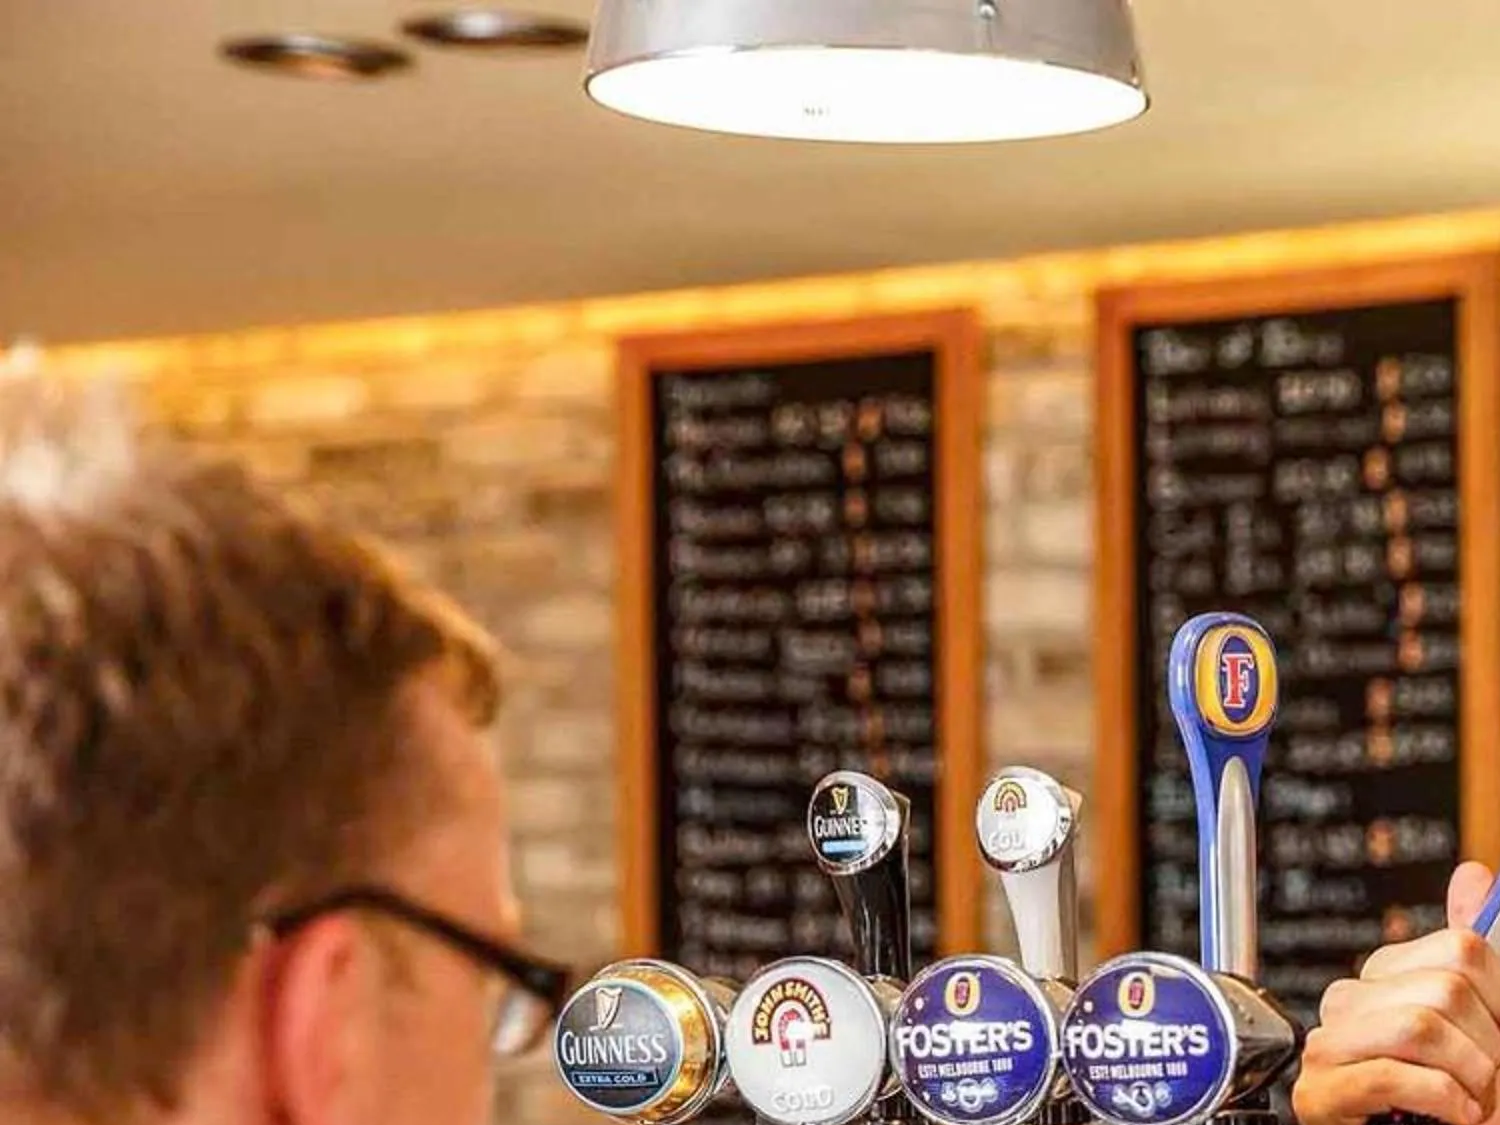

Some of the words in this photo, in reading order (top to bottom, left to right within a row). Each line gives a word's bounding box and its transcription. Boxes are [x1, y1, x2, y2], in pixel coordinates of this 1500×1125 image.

[1221, 653, 1255, 709] F
[814, 815, 871, 839] GUINNE
[754, 984, 784, 1042] JOHN
[561, 1031, 668, 1065] GUINNESS
[896, 1020, 1034, 1060] FOSTER'S
[1066, 1020, 1210, 1060] FOSTER'S
[578, 1074, 612, 1084] EXTRA
[613, 1072, 647, 1084] COLD
